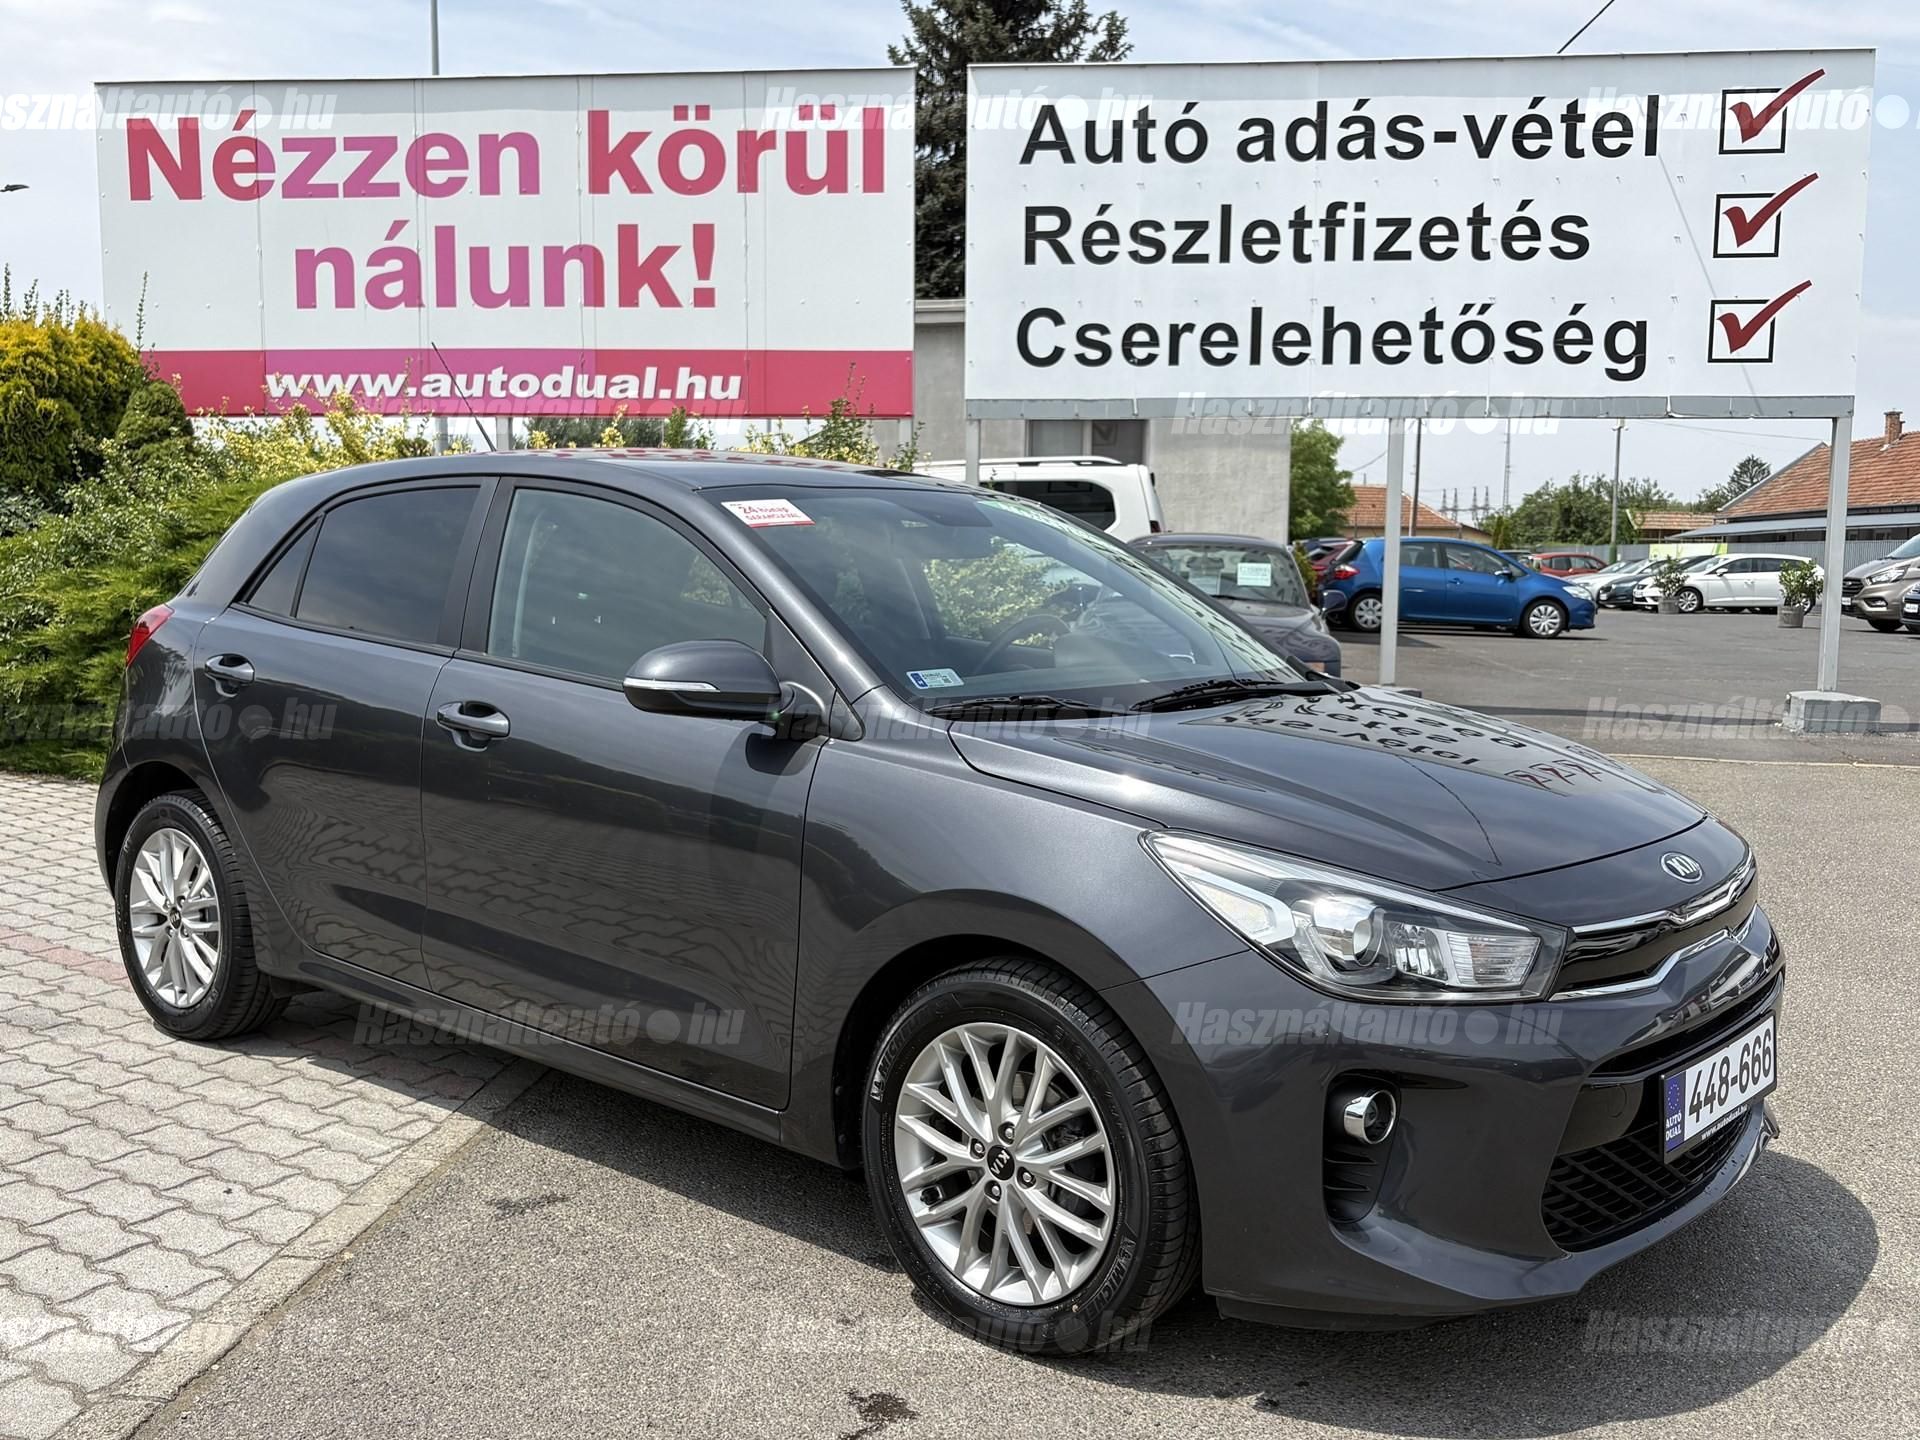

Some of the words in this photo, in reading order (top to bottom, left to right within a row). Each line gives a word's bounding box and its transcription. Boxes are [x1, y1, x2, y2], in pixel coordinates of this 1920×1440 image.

[126, 110, 540, 201] Nézzen
[588, 104, 885, 196] körül
[1019, 101, 1208, 165] Autó
[1236, 94, 1660, 163] adás-vétel
[296, 220, 715, 309] nálunk!
[1024, 199, 1590, 265] Részletfizetés
[1016, 303, 1647, 382] Cserelehetőség
[266, 365, 742, 400] www.autodual.hu
[1689, 1028, 1771, 1123] 448-666
[1666, 1110, 1682, 1127] AUTÓ
[1666, 1127, 1682, 1141] DUAL
[990, 1149, 1011, 1175] KIA
